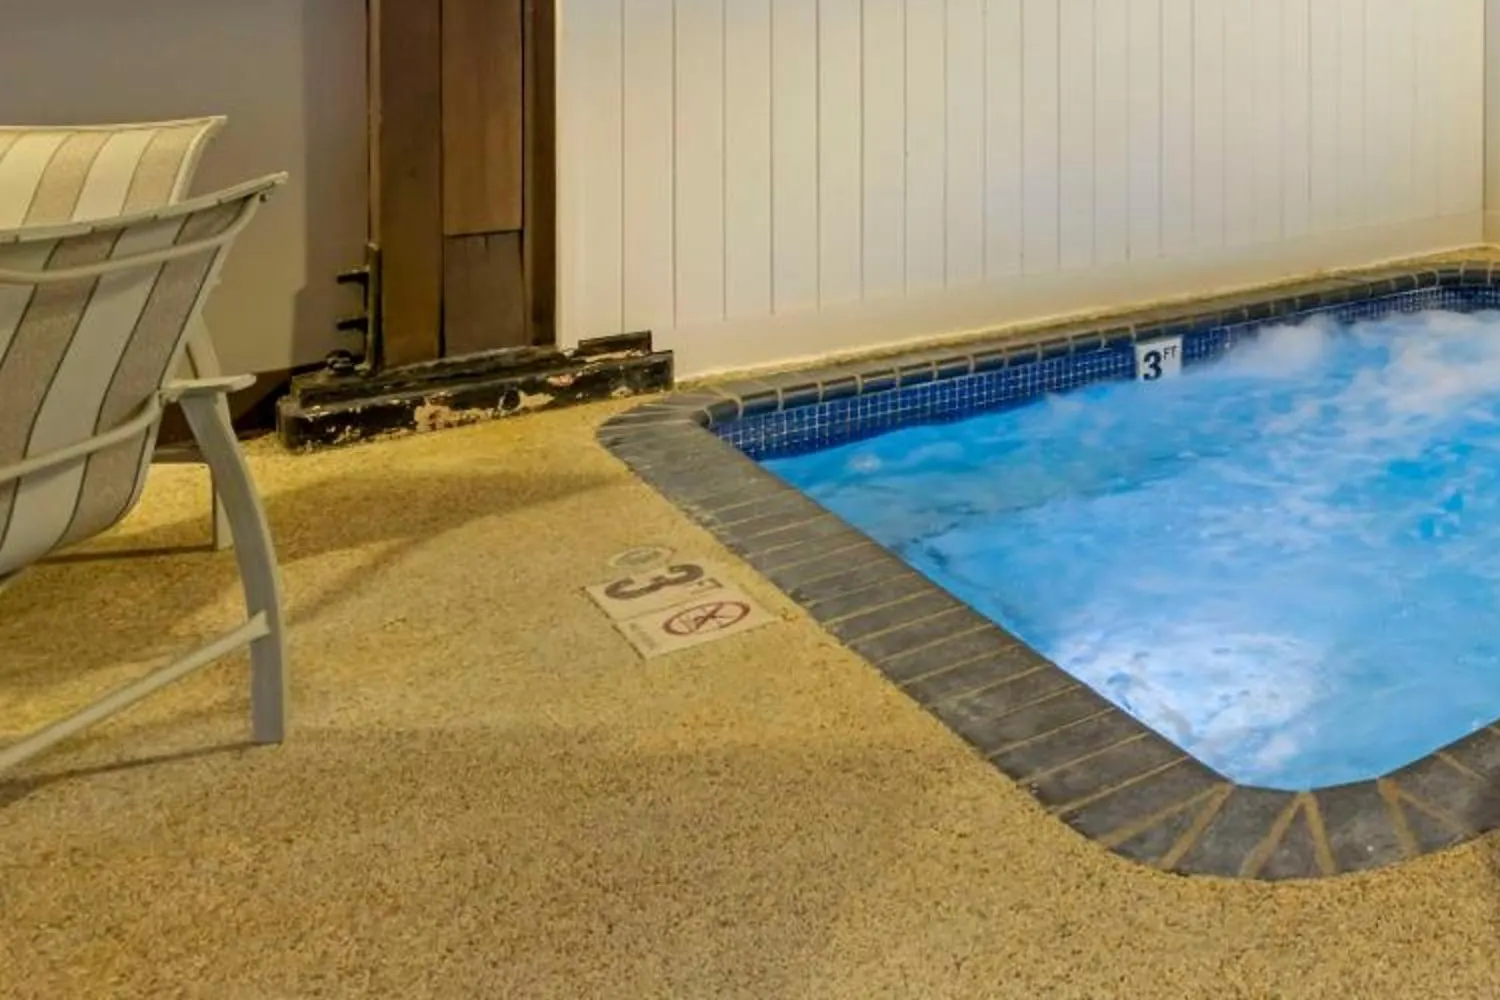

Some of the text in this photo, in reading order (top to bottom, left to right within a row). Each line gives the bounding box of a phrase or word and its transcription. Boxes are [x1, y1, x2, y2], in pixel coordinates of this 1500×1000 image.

[1144, 345, 1178, 381] 3 FT
[605, 563, 704, 600] 3
